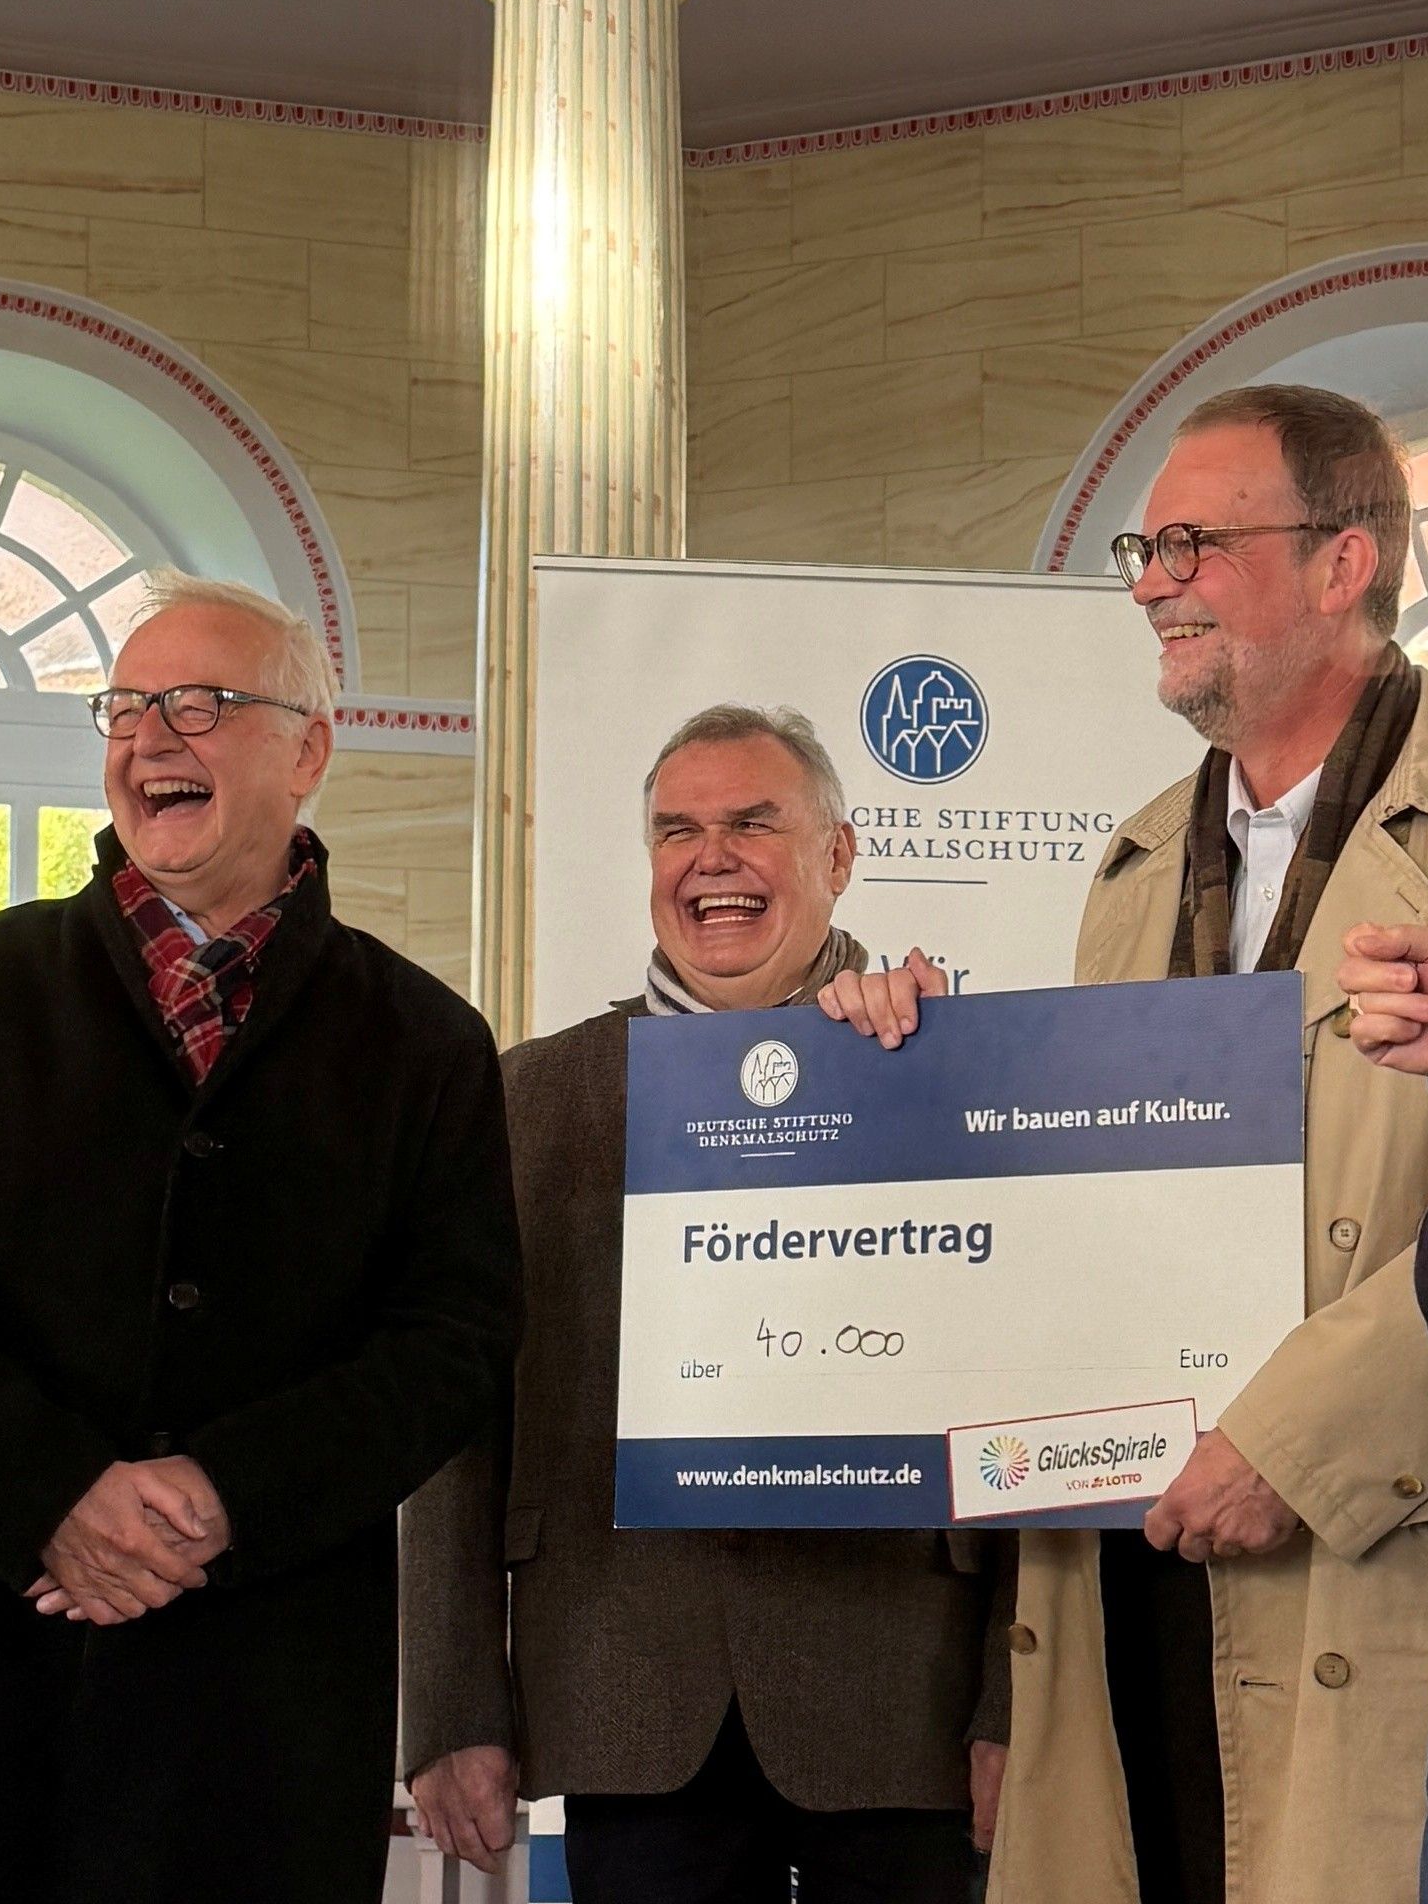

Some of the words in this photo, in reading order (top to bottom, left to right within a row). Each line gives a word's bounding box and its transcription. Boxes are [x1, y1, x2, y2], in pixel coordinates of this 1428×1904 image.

[850, 806, 922, 829] CHE
[937, 809, 1115, 833] STIFTUNG
[855, 837, 1086, 862] MALSCHUTZ
[686, 1117, 768, 1134] DEUTSCHE
[773, 1113, 854, 1130] STIFTUNG
[964, 1108, 1008, 1133] Wir
[1012, 1106, 1092, 1131] bauen
[1096, 1099, 1141, 1127] auf
[1144, 1097, 1232, 1123] Kultur.
[699, 1128, 840, 1148] DENKMALSCHUTZ
[683, 1218, 993, 1264] Fördervertrag
[680, 1359, 724, 1379] über
[1179, 1348, 1229, 1368] Euro
[1037, 1432, 1168, 1472] GlücksSpirale
[676, 1463, 923, 1487] www.denkmalschutz.de
[1105, 1473, 1143, 1487] LOTTO
